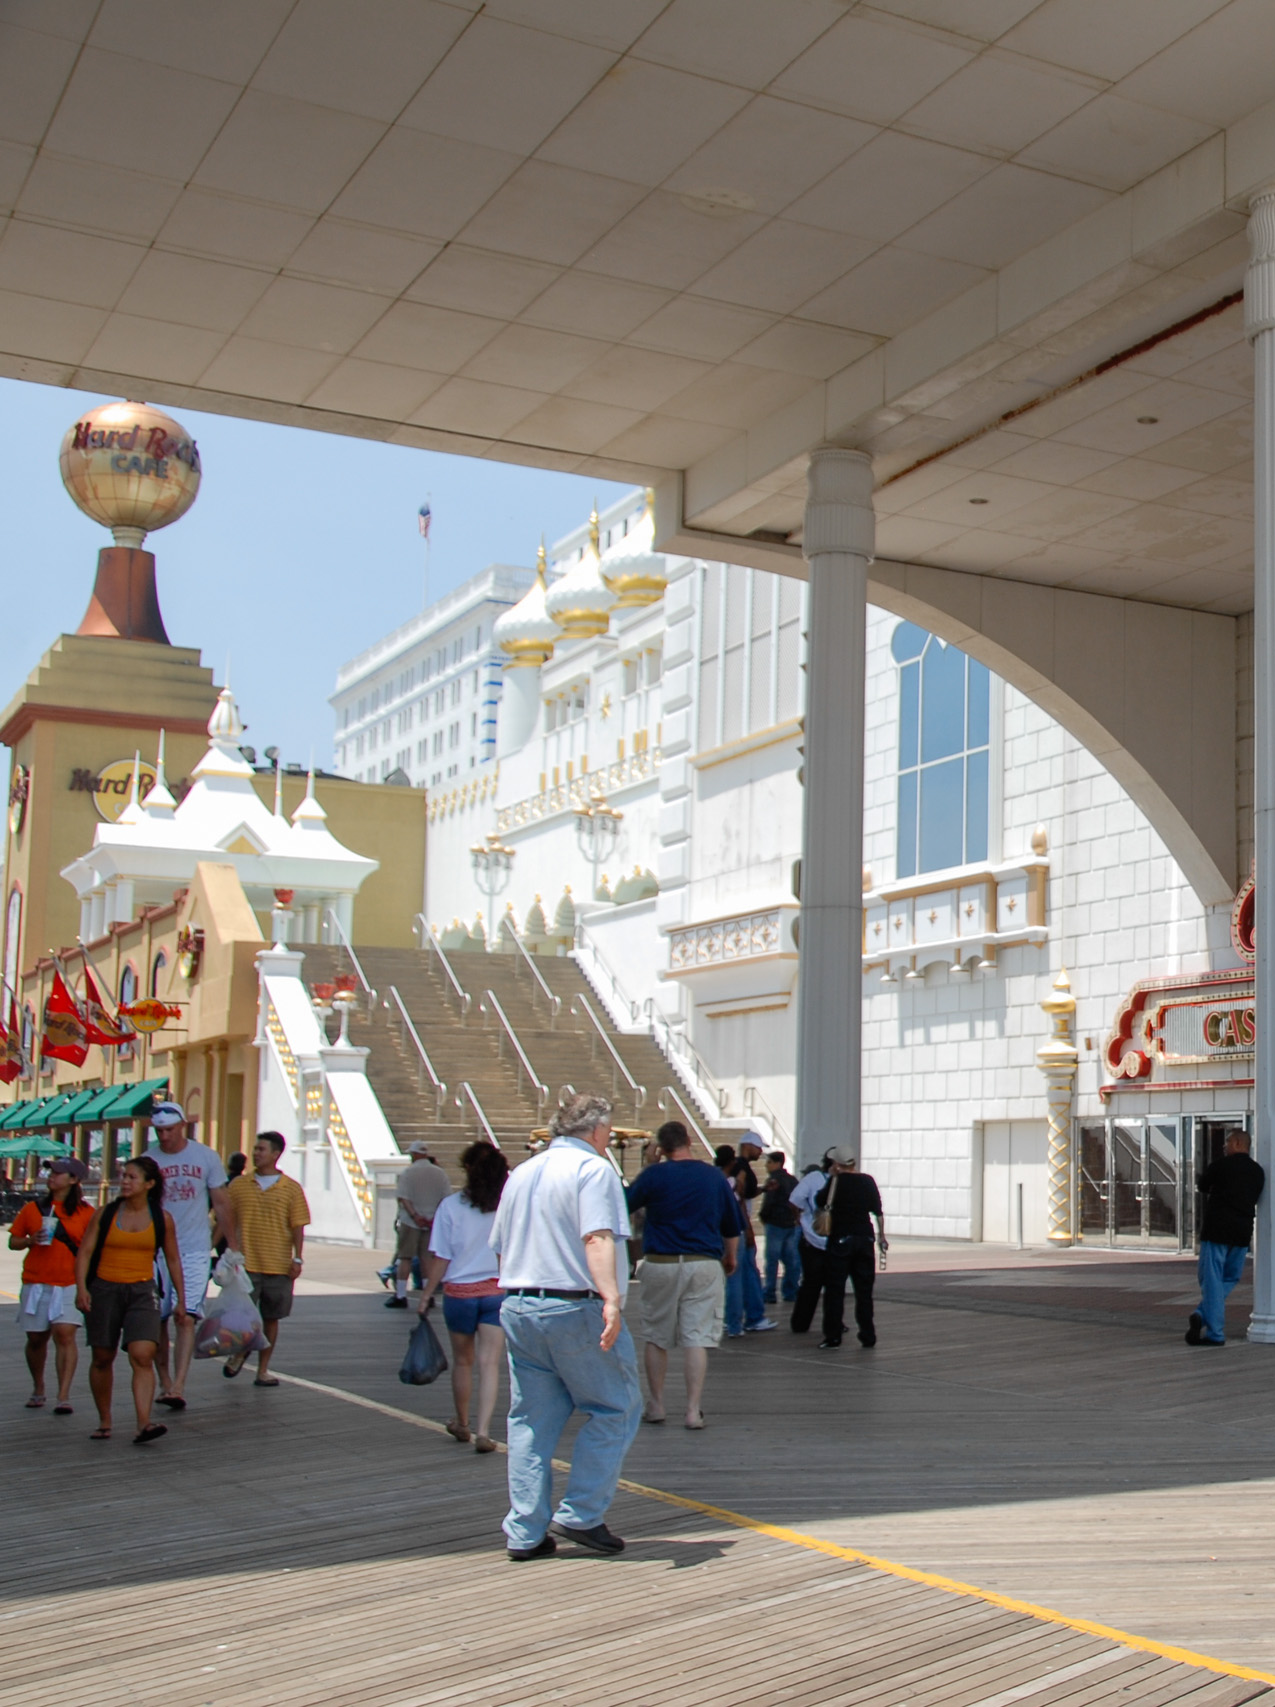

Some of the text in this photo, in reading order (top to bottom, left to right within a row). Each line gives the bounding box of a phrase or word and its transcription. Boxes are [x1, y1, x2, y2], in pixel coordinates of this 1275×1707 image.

[72, 421, 140, 451] Hard
[110, 454, 168, 479] CAFE
[69, 768, 132, 795] Hard
[1203, 1007, 1256, 1047] CAS
